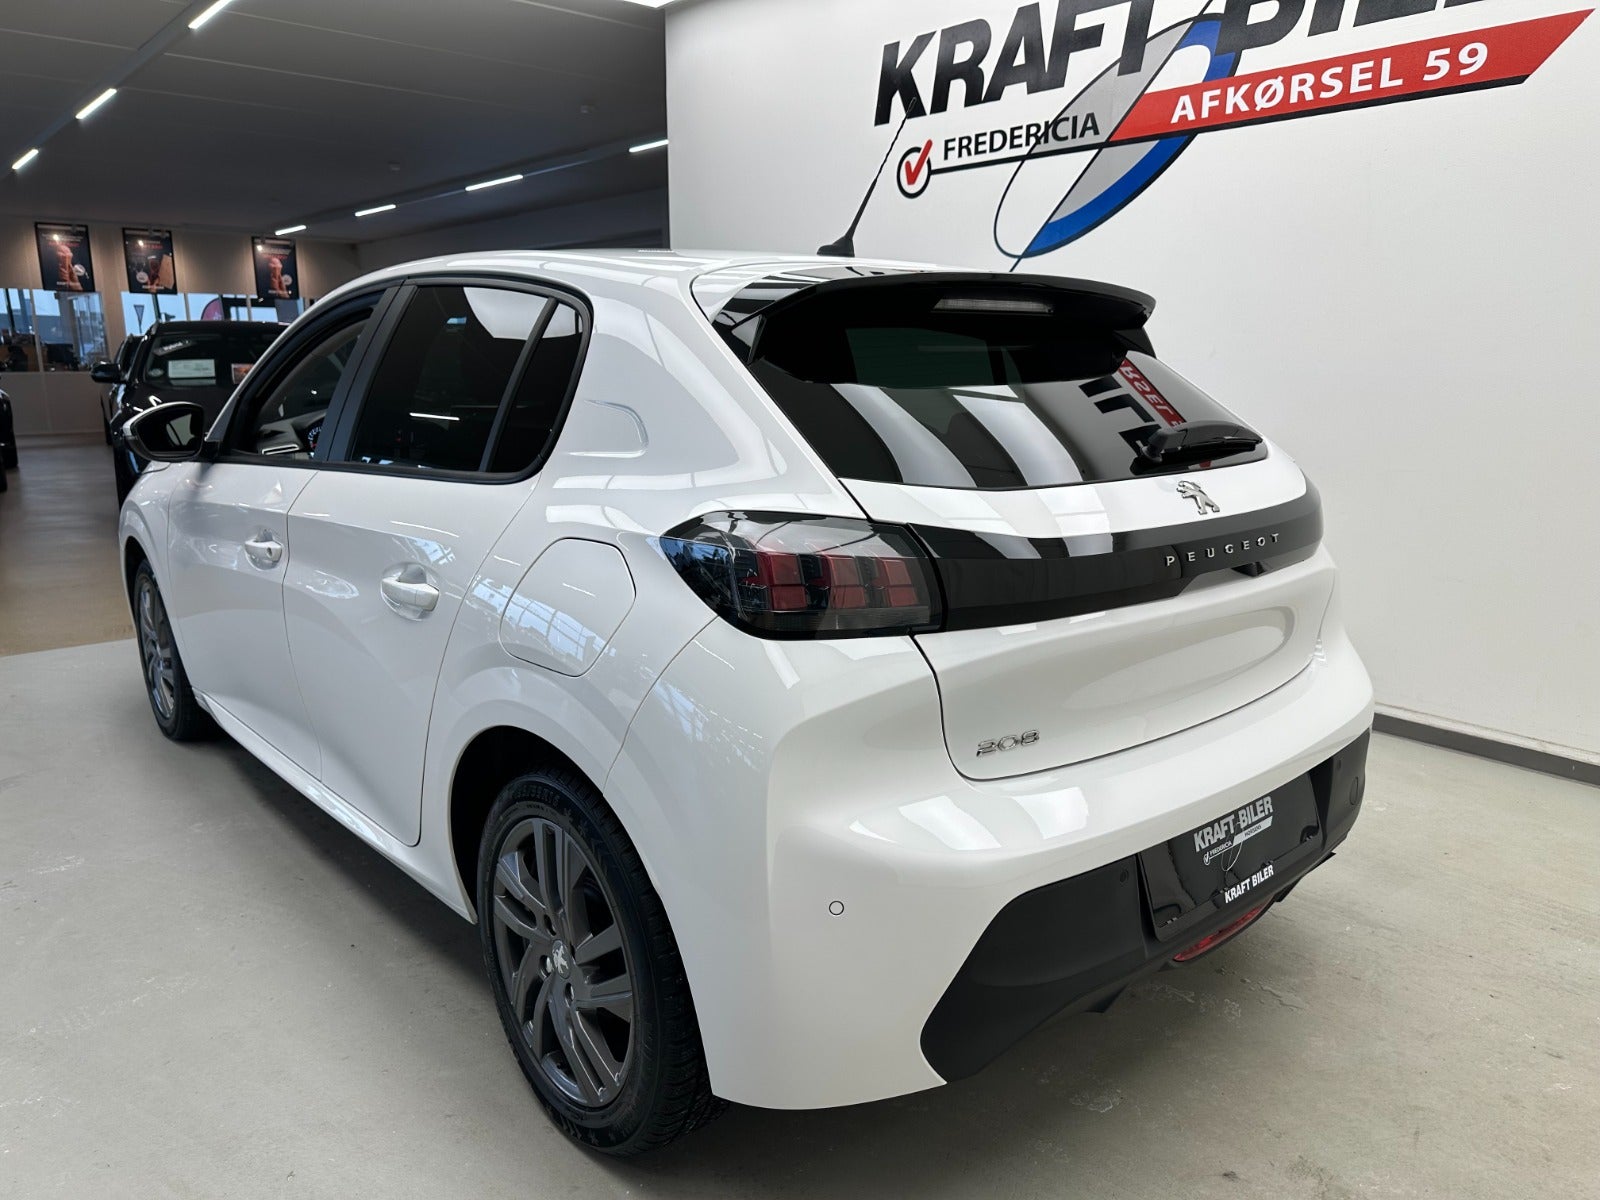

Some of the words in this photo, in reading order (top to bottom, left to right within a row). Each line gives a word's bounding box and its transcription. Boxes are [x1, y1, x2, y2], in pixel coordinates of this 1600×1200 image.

[874, 0, 1153, 126] KRAFT
[1170, 57, 1404, 123] AFKØRSEL
[1422, 42, 1489, 81] 59
[943, 112, 1100, 162] FREDERICIA
[1165, 532, 1280, 567] PEUGEOT
[976, 730, 1040, 757] 208
[1193, 814, 1235, 852] KRAFT
[1238, 796, 1274, 828] BILER
[1224, 879, 1250, 903] KRAFT
[1252, 865, 1274, 887] BILER
